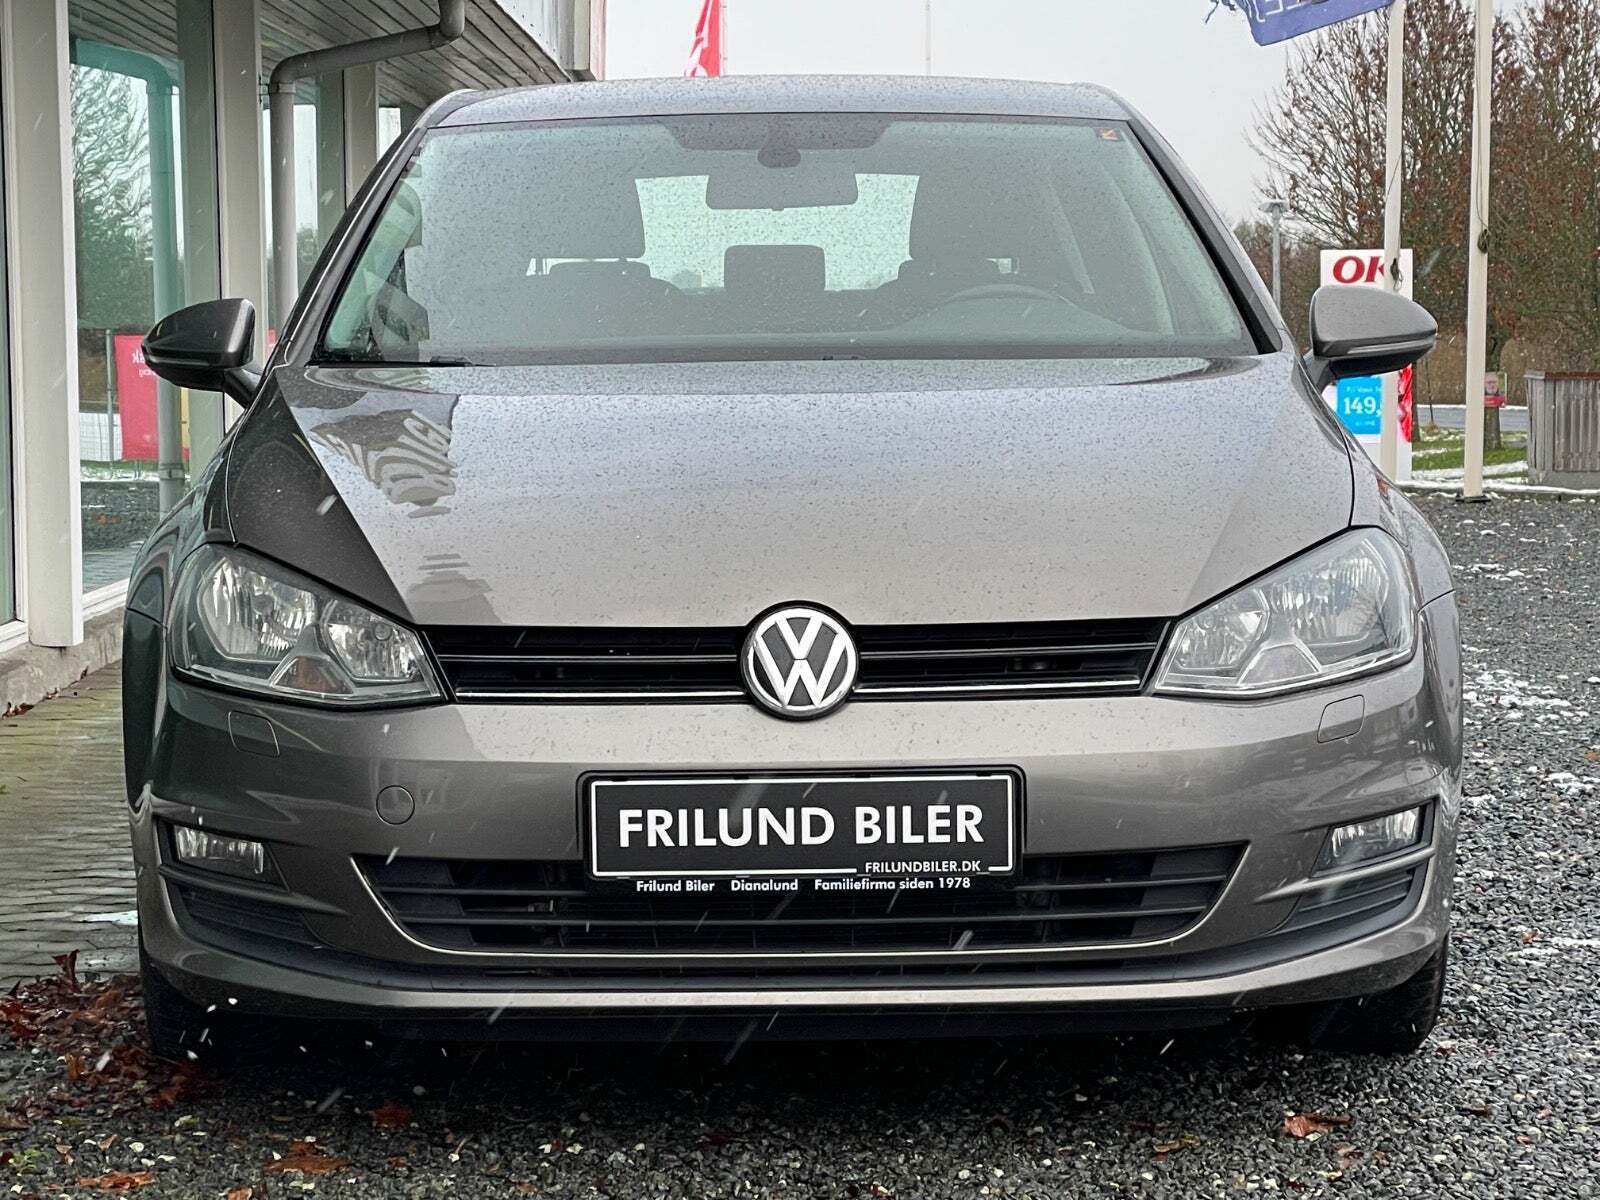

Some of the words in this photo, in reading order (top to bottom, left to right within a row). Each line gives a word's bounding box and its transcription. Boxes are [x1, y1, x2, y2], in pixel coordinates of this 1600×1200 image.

[618, 807, 835, 848] FRILUND
[855, 804, 986, 844] BILER
[864, 860, 982, 874] FRILUNDBILER.DK
[636, 880, 682, 892] Frilund
[685, 880, 716, 892] Biler
[730, 879, 799, 891] Dianalund
[814, 878, 896, 891] Familiefirma
[899, 877, 934, 890] siden
[938, 877, 971, 889] 1978
